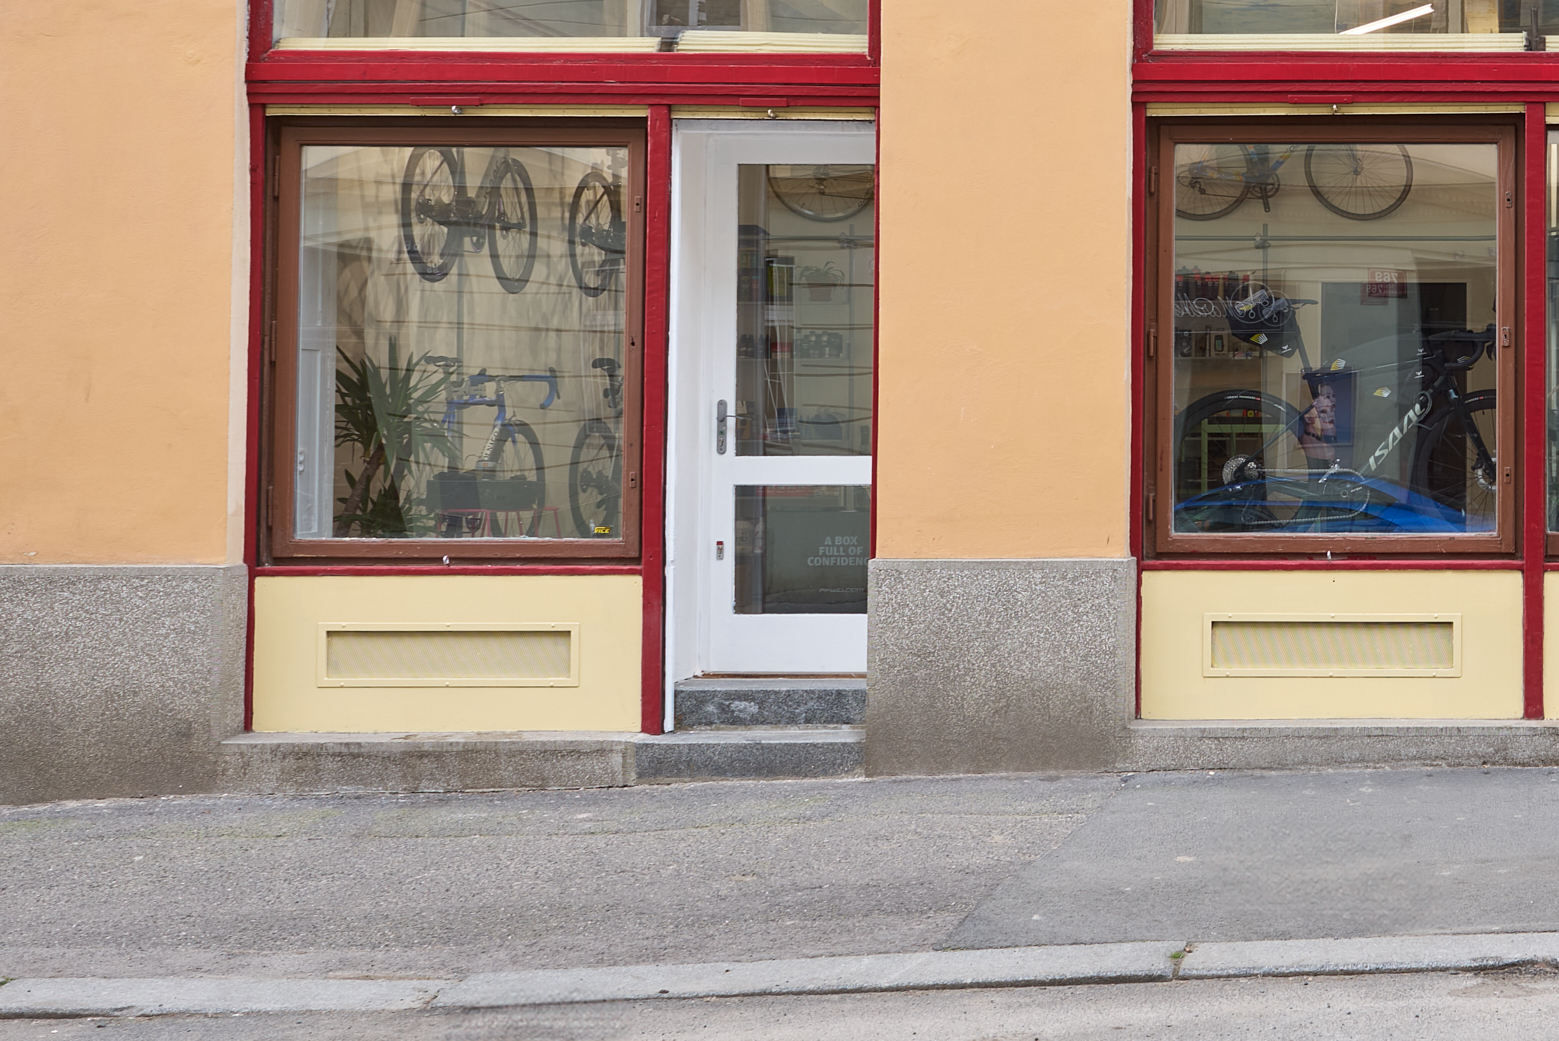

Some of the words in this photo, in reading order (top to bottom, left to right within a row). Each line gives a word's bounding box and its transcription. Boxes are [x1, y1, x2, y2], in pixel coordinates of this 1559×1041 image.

[1368, 402, 1426, 472] ISAAC
[824, 536, 832, 546] A
[834, 536, 858, 546] BOX
[818, 546, 846, 556] FULL
[848, 546, 863, 556] OF
